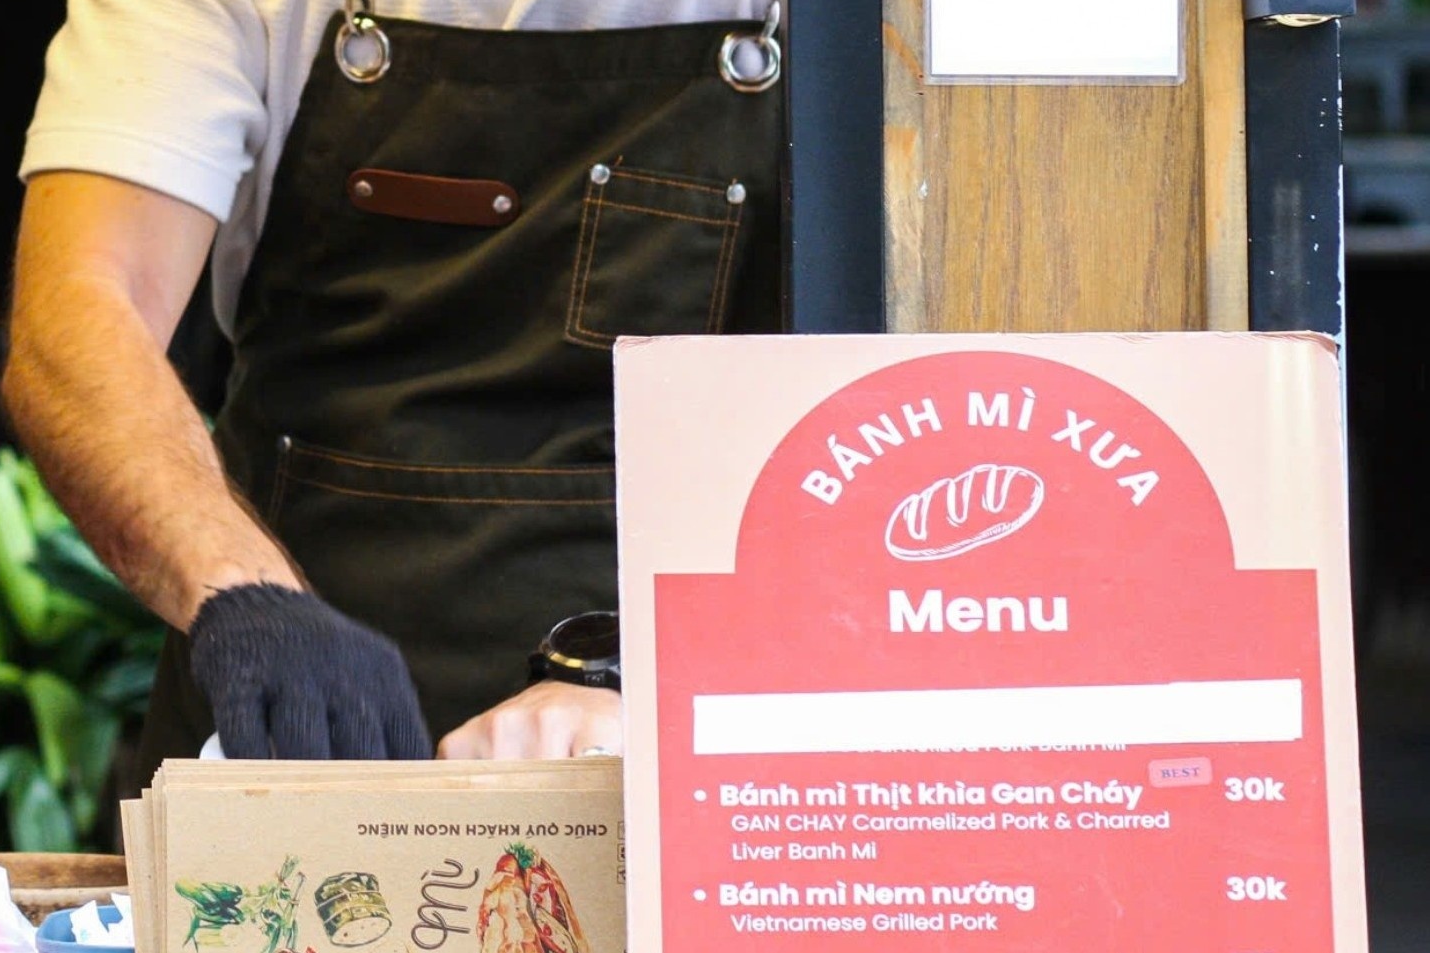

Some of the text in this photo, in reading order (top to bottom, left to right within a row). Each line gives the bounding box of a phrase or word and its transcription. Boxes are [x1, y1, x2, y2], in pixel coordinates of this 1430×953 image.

[800, 388, 1160, 506] BÁNH MÌ XƯA
[890, 590, 1067, 632] Menu
[1160, 766, 1201, 779] BEST
[720, 780, 1142, 810] Bánh mì Thịt khìa Gan Cháy
[1226, 778, 1284, 801] 30k
[358, 823, 608, 839] CHÚC QUÝ KHÁCH NGON MIỆNG
[732, 812, 1169, 831] GAN CHAY Caramelized Pork & Charred
[733, 842, 876, 860] Liver Banh Mi
[720, 881, 1034, 911] Bánh mì Nem nướng
[1227, 877, 1286, 900] 30k
[731, 913, 996, 931] Vietnamese Grilled Pork
